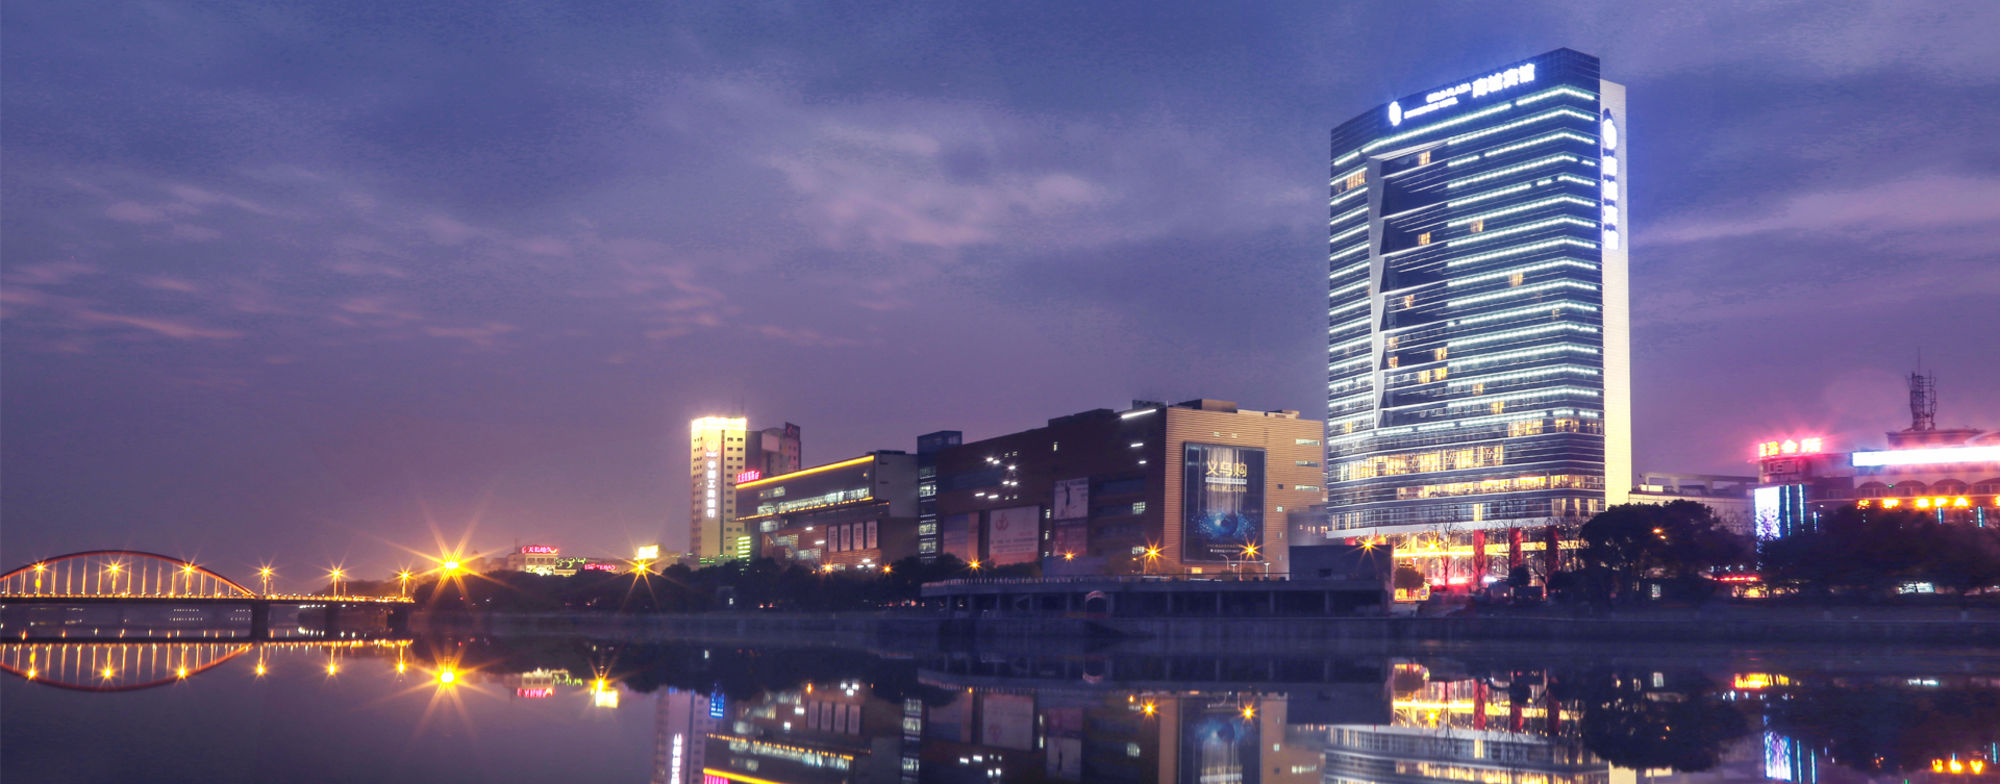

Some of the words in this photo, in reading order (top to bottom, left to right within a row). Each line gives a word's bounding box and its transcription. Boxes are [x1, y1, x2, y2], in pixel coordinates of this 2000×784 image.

[1205, 460, 1248, 478] 义乌购
[1915, 497, 1969, 508] SPA
